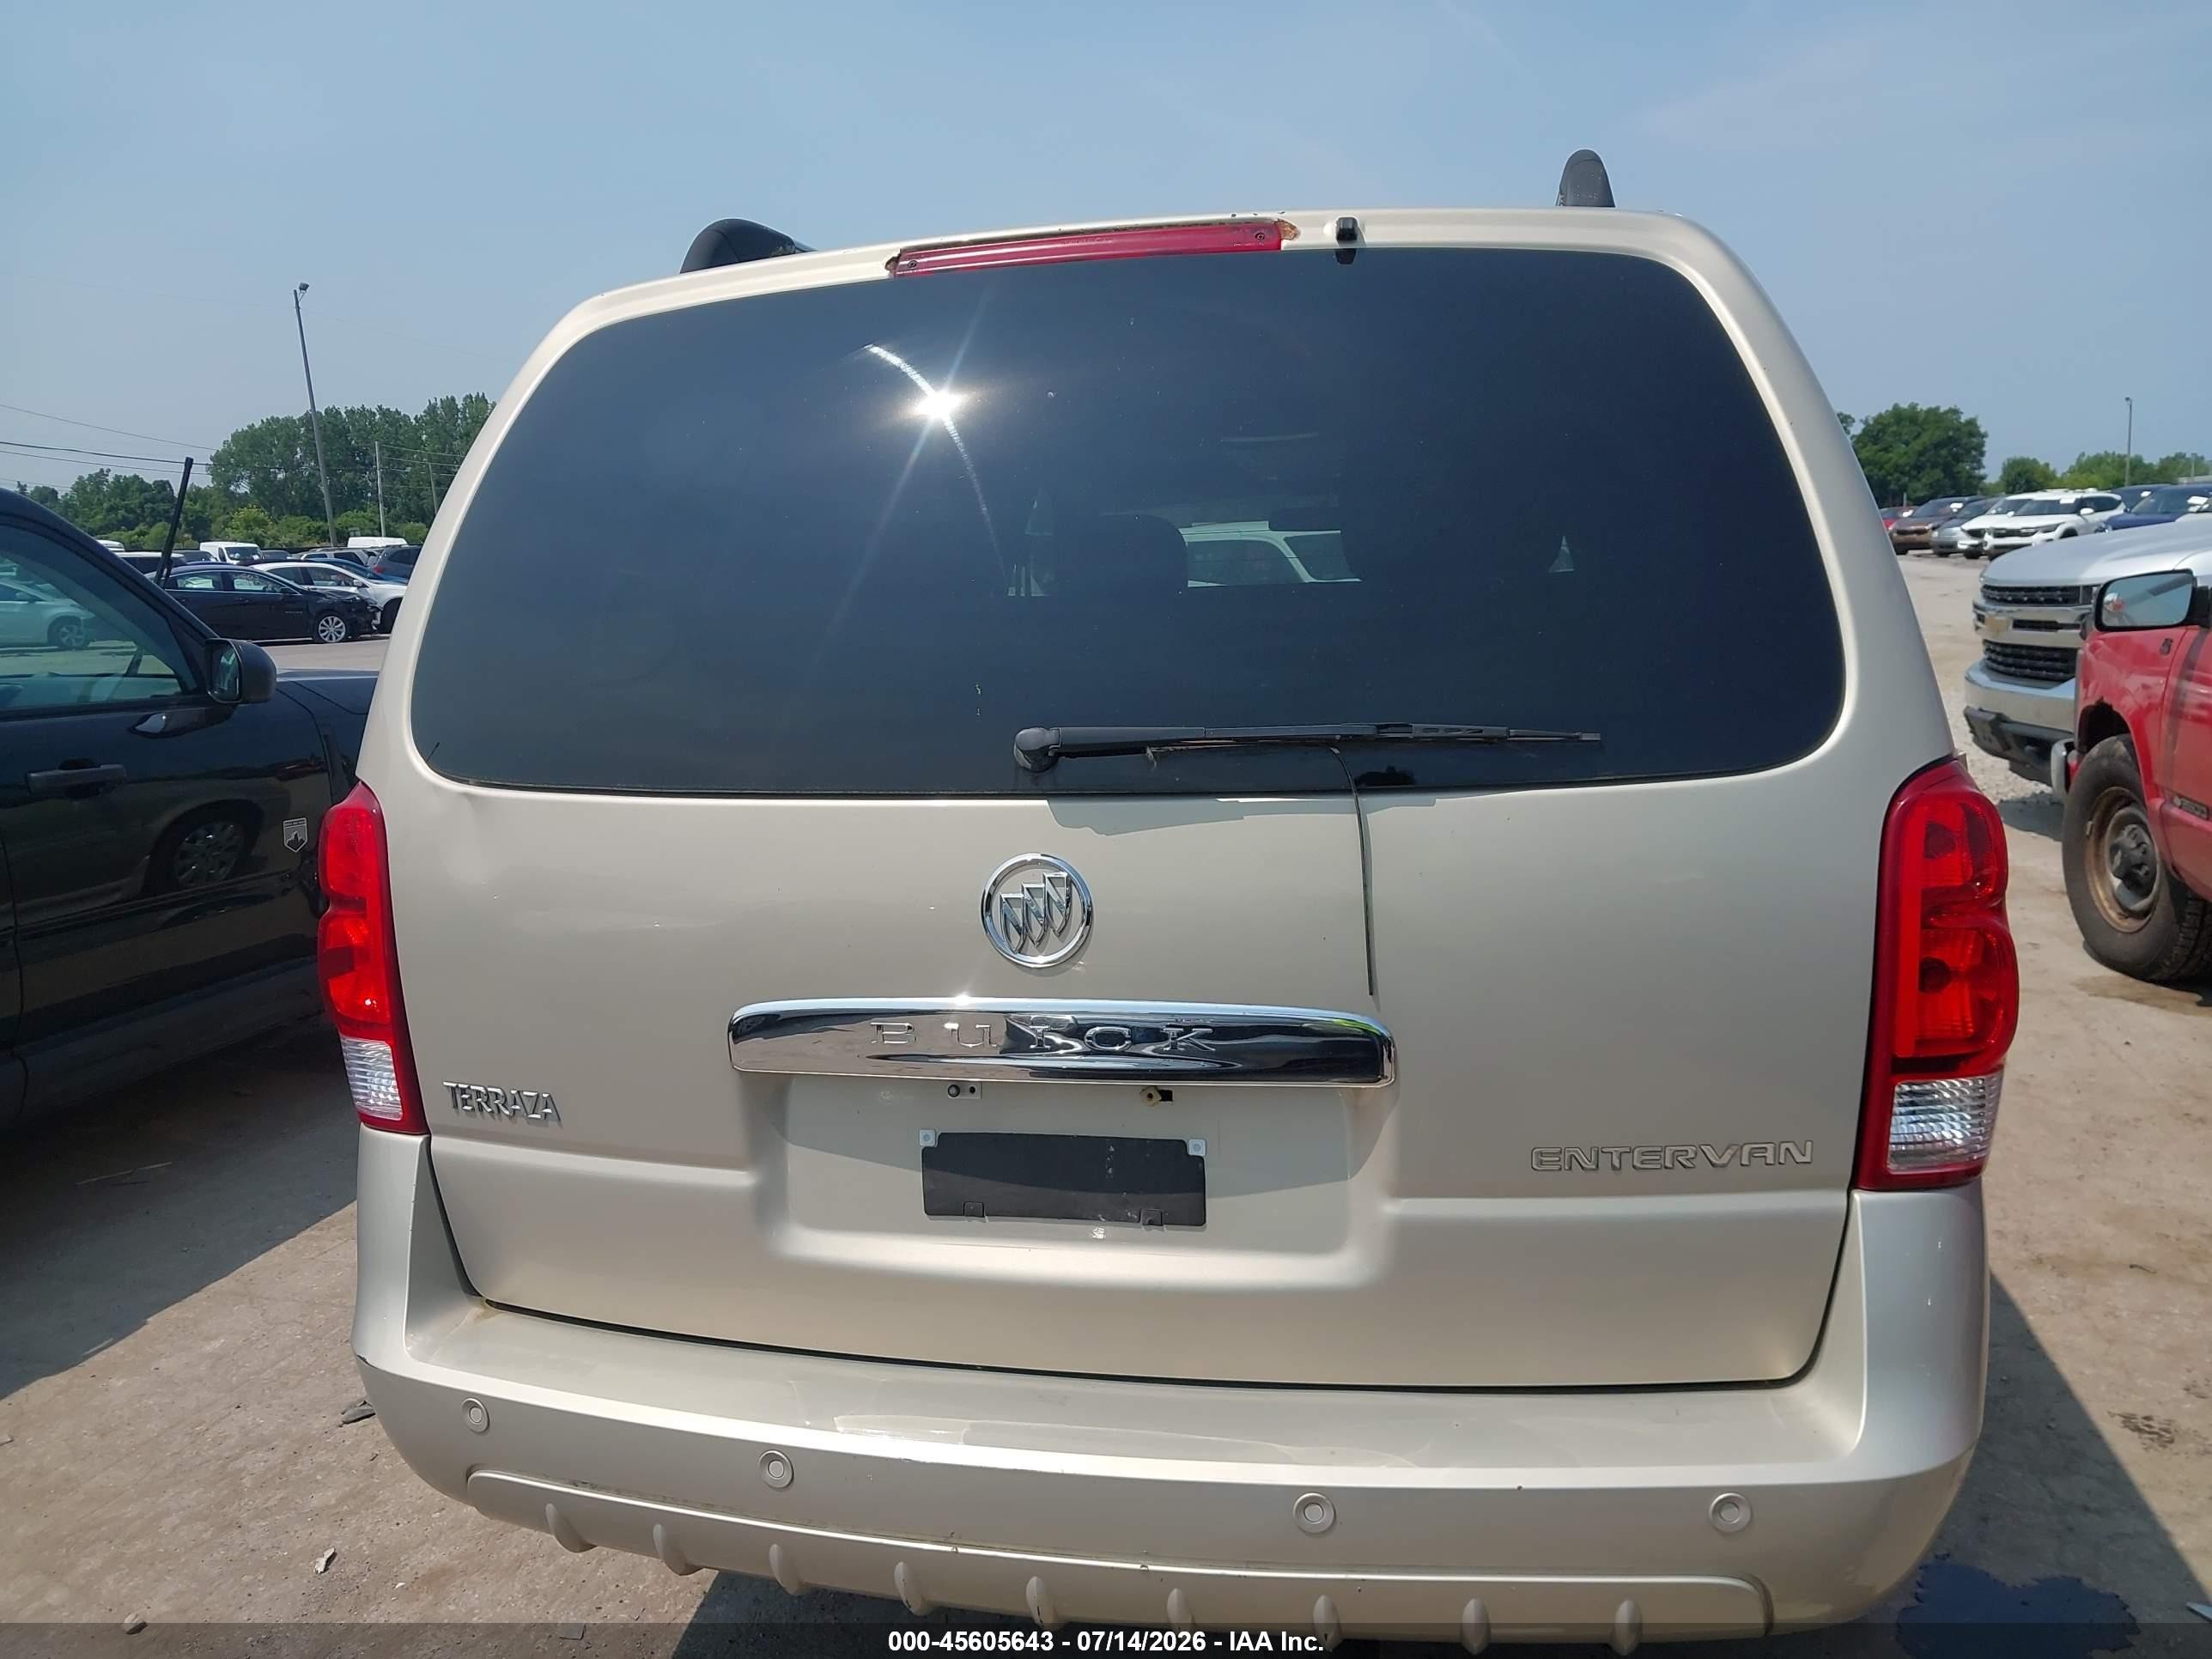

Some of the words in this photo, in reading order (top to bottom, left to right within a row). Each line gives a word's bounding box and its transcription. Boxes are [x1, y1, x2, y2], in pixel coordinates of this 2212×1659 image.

[870, 1021, 1218, 1052] BUICK
[442, 1080, 562, 1122] TERRAZA
[1530, 1139, 1814, 1173] ENTERVAN
